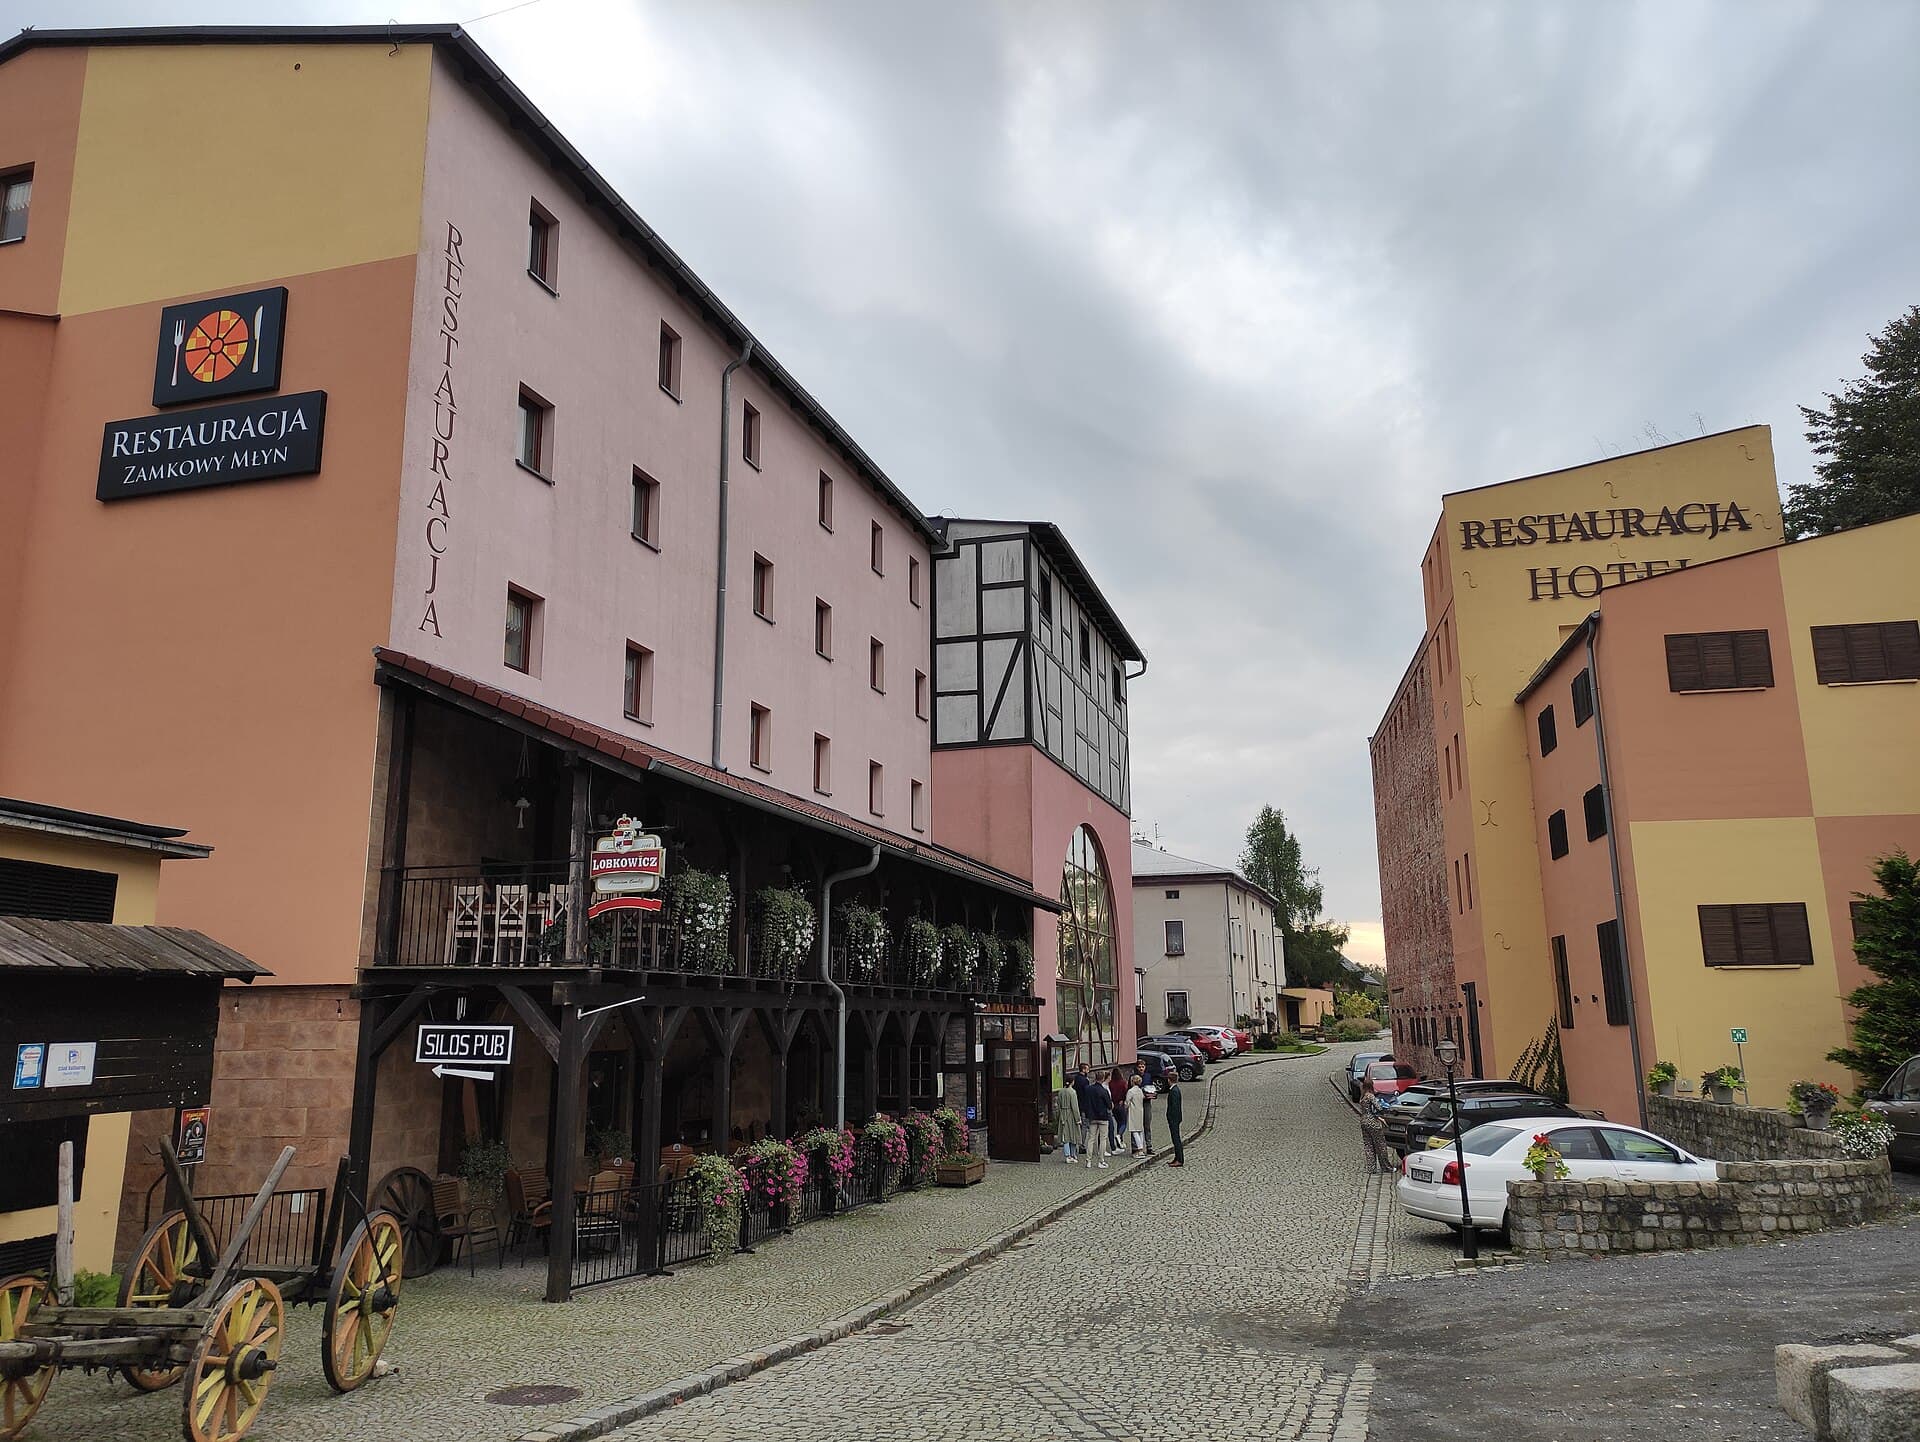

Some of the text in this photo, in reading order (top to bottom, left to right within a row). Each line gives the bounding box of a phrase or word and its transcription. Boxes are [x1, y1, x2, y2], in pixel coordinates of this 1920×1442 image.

[417, 220, 465, 639] RESTAURACJA
[1460, 501, 1753, 550] RESTAURACJA
[1525, 559, 1691, 601] HOT
[592, 855, 658, 871] LOBKOWICZ
[424, 1033, 505, 1057] SILOS PUB
